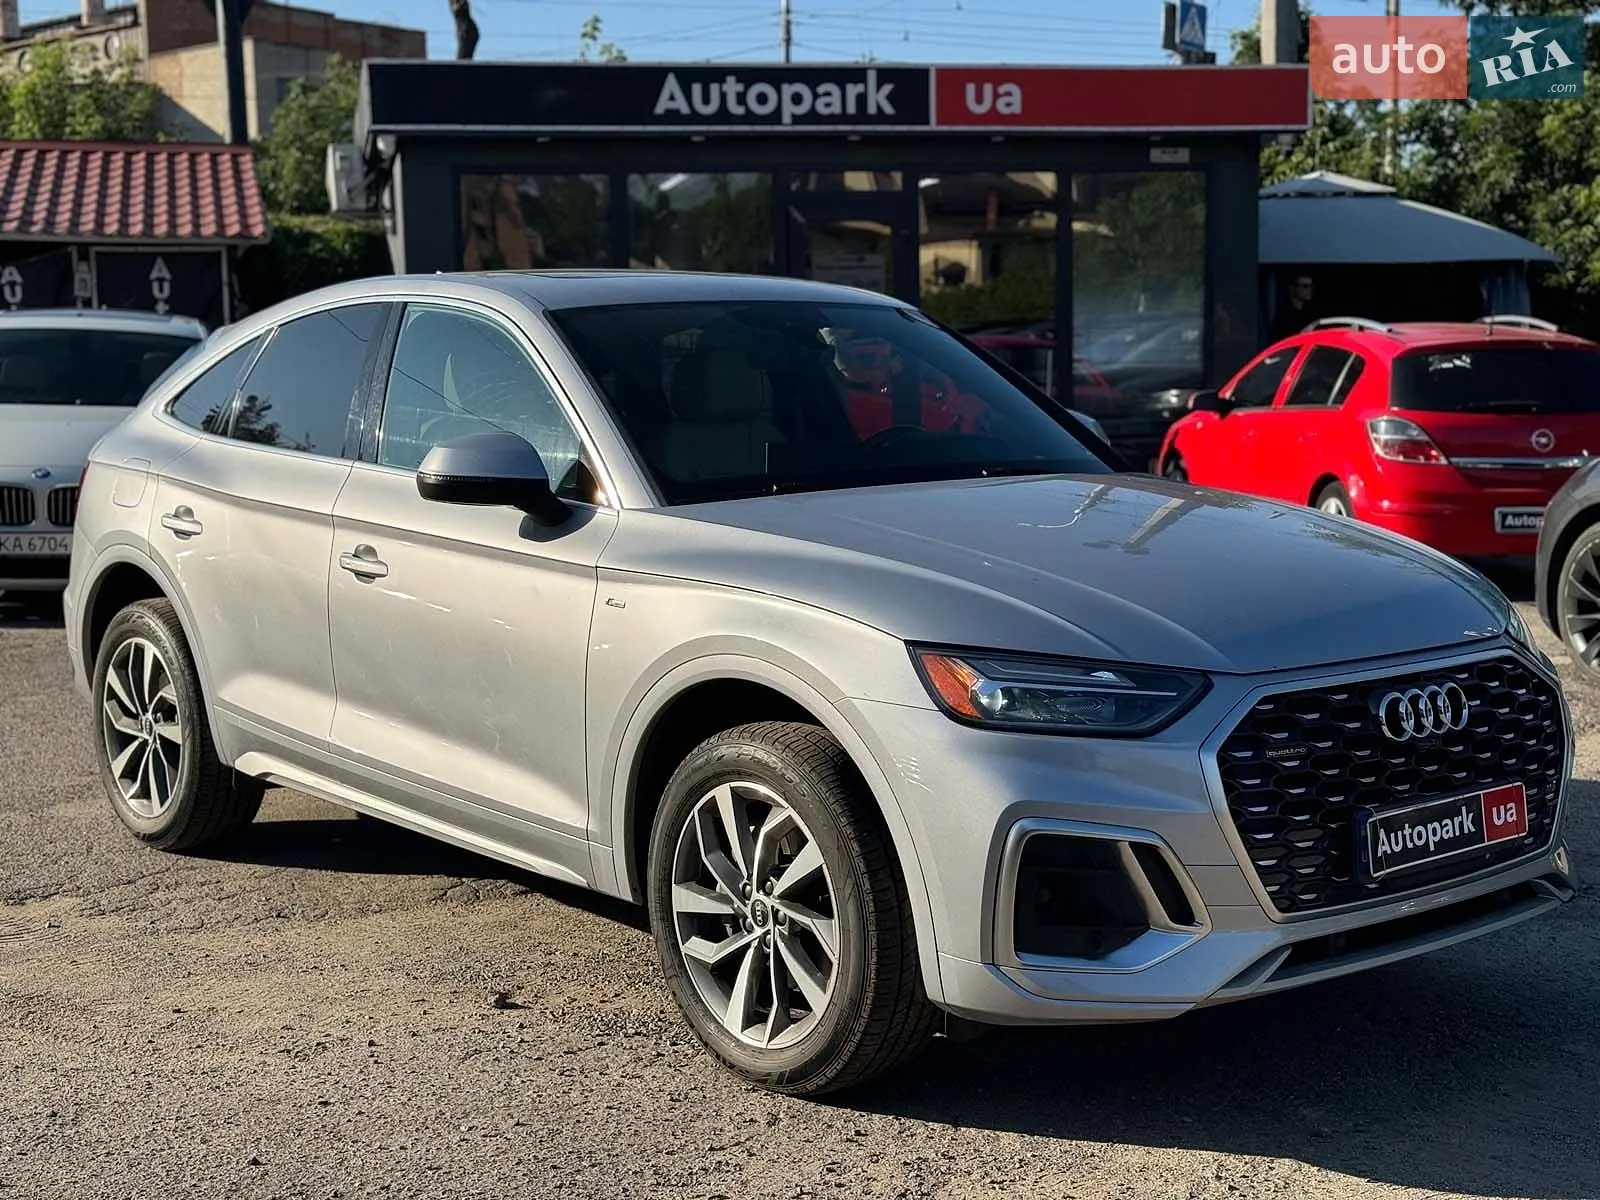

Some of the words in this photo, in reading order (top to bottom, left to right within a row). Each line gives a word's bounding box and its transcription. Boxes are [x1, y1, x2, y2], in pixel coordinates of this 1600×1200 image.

[653, 71, 896, 125] Autopark
[964, 82, 1023, 115] ua
[28, 536, 68, 552] 6704
[1377, 806, 1476, 858] Autopark
[1492, 802, 1518, 826] ua
